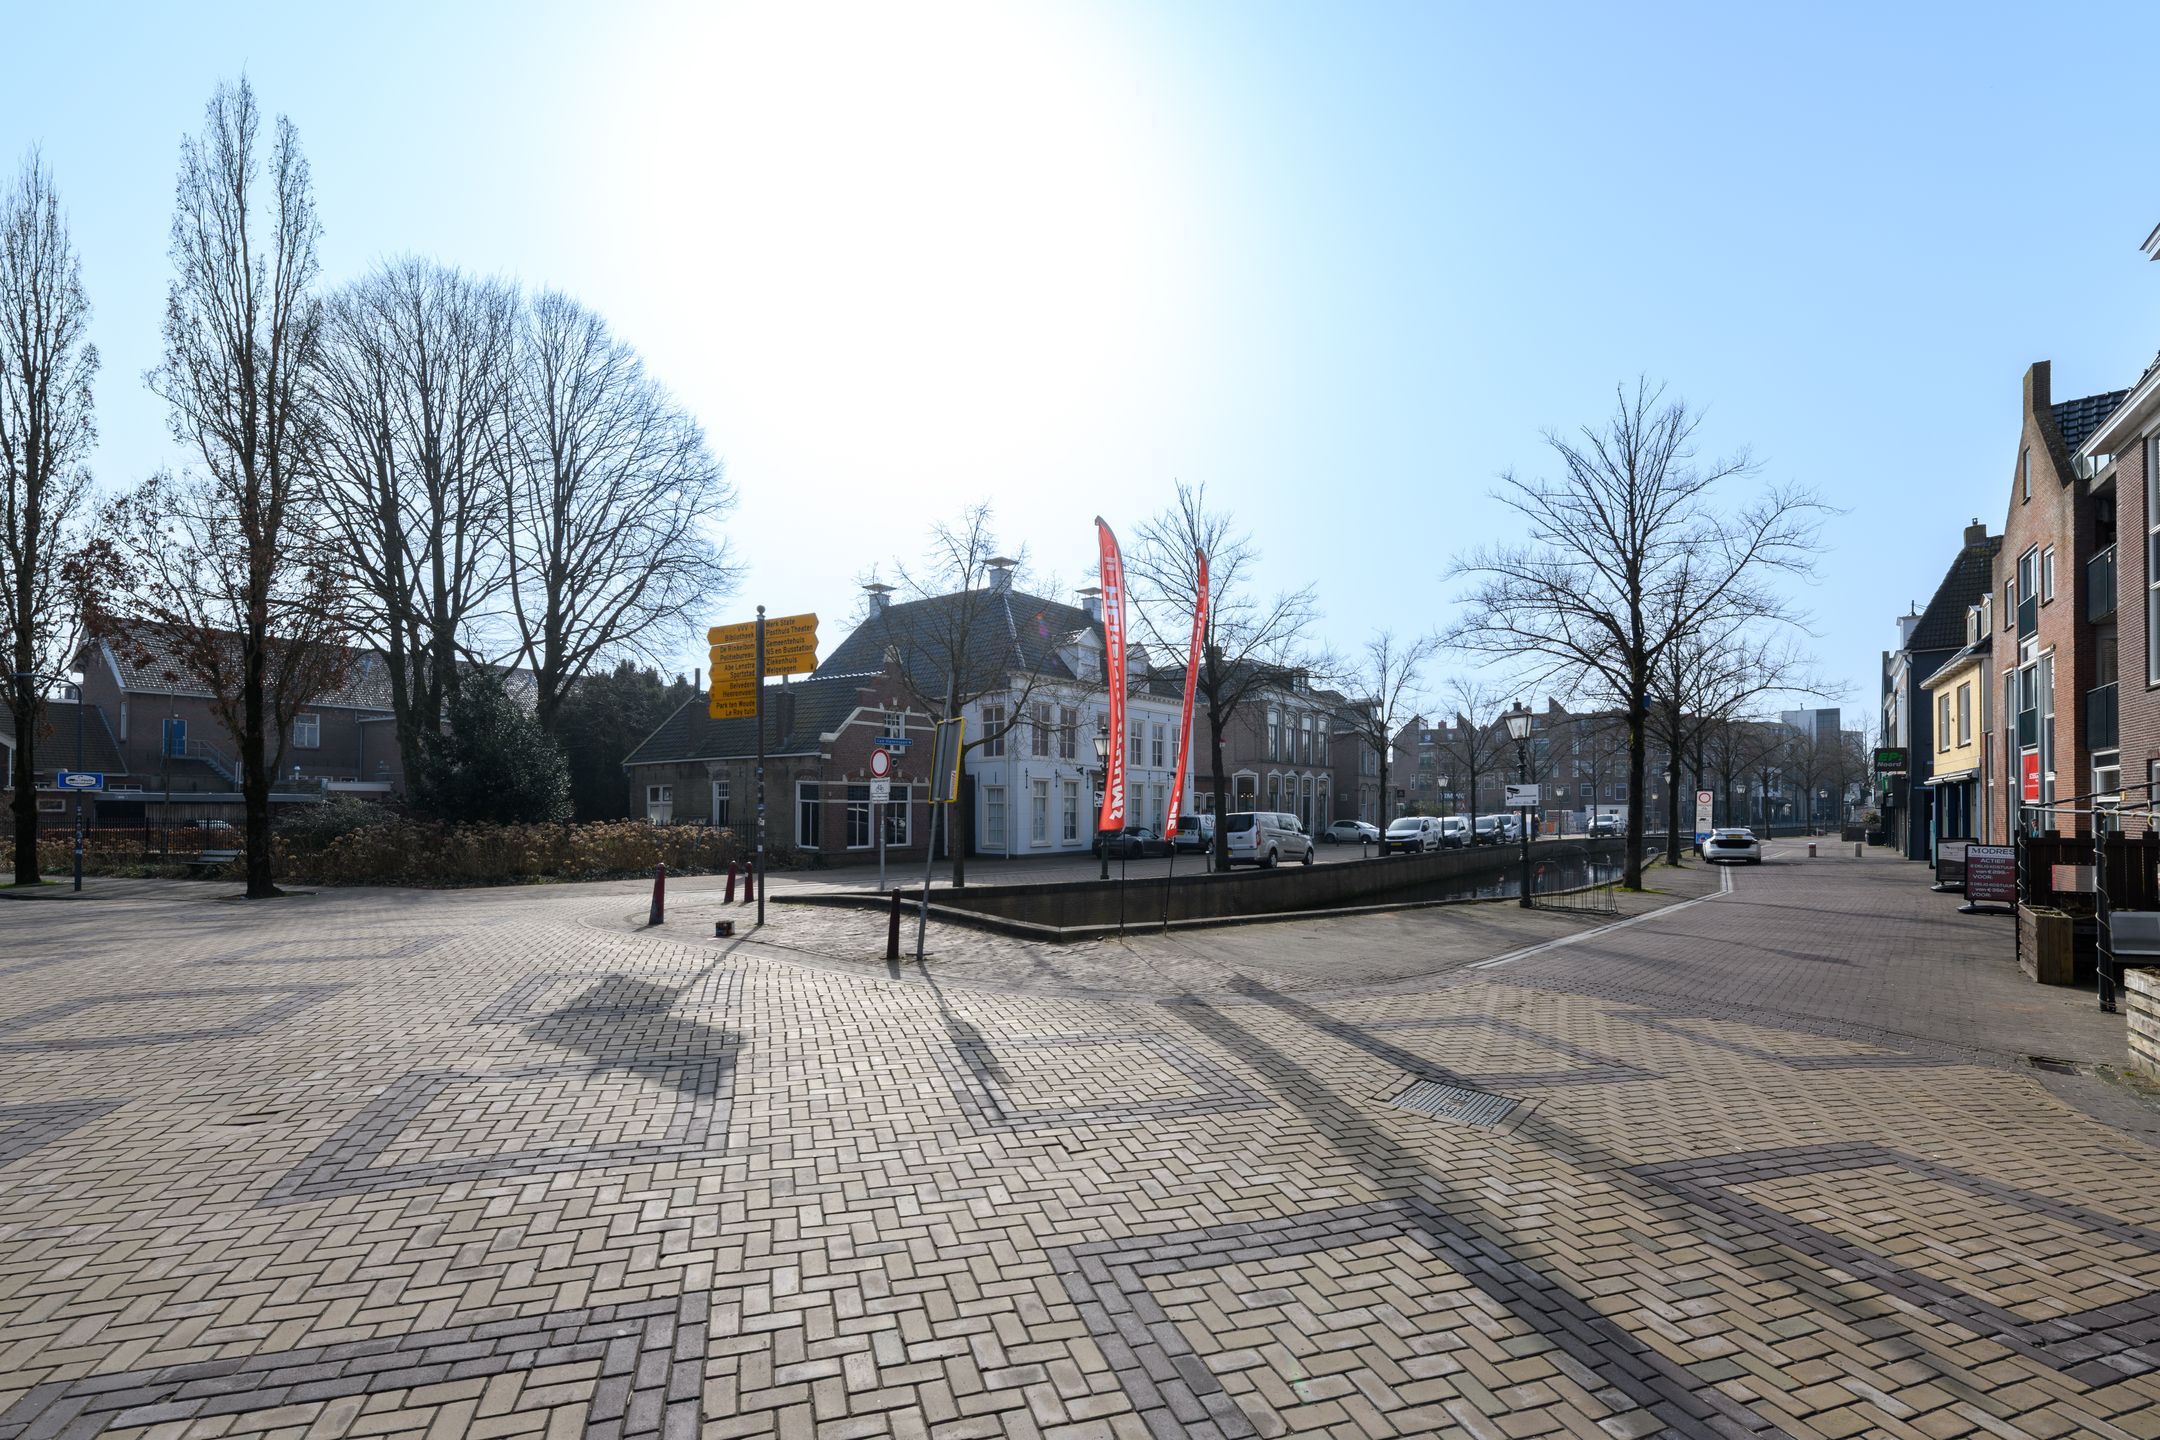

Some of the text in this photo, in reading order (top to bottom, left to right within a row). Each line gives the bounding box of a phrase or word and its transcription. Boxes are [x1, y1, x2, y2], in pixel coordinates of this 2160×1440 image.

[737, 624, 749, 632] VVV
[766, 624, 813, 635] Posthuis Theater
[725, 633, 754, 641] Bibliotheek
[766, 637, 805, 647] Gemeentehuis
[783, 645, 813, 653] Busstation
[720, 652, 754, 661] Politiebureau
[766, 657, 797, 665] Ziekenhuis
[735, 662, 755, 670] Lenstra
[766, 665, 797, 674] Welgelegen
[730, 670, 755, 679] Sportstad
[730, 681, 755, 689] Belvedere
[1878, 752, 1904, 762] EP:
